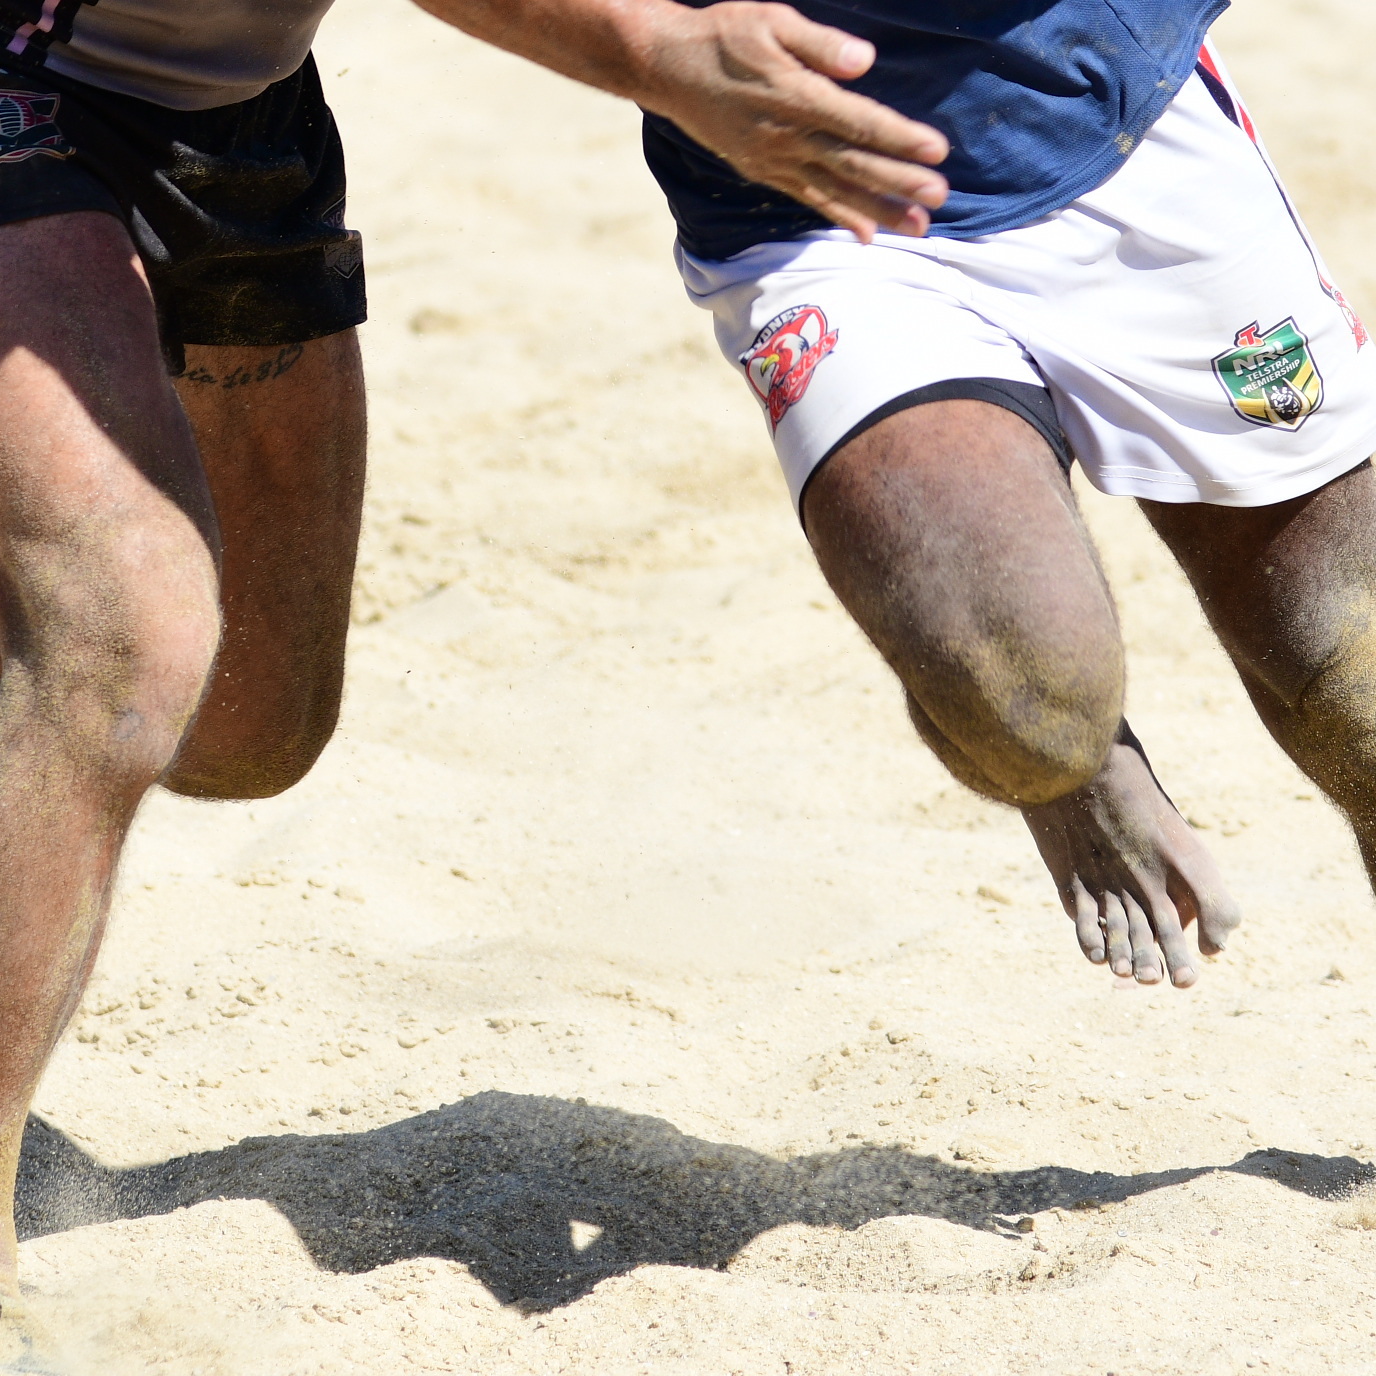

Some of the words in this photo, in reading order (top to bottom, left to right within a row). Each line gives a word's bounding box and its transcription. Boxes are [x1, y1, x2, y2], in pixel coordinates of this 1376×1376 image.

[1232, 340, 1296, 377] NRL
[1240, 358, 1301, 396] PREMIERSHIP
[1246, 357, 1289, 382] TELSTRA
